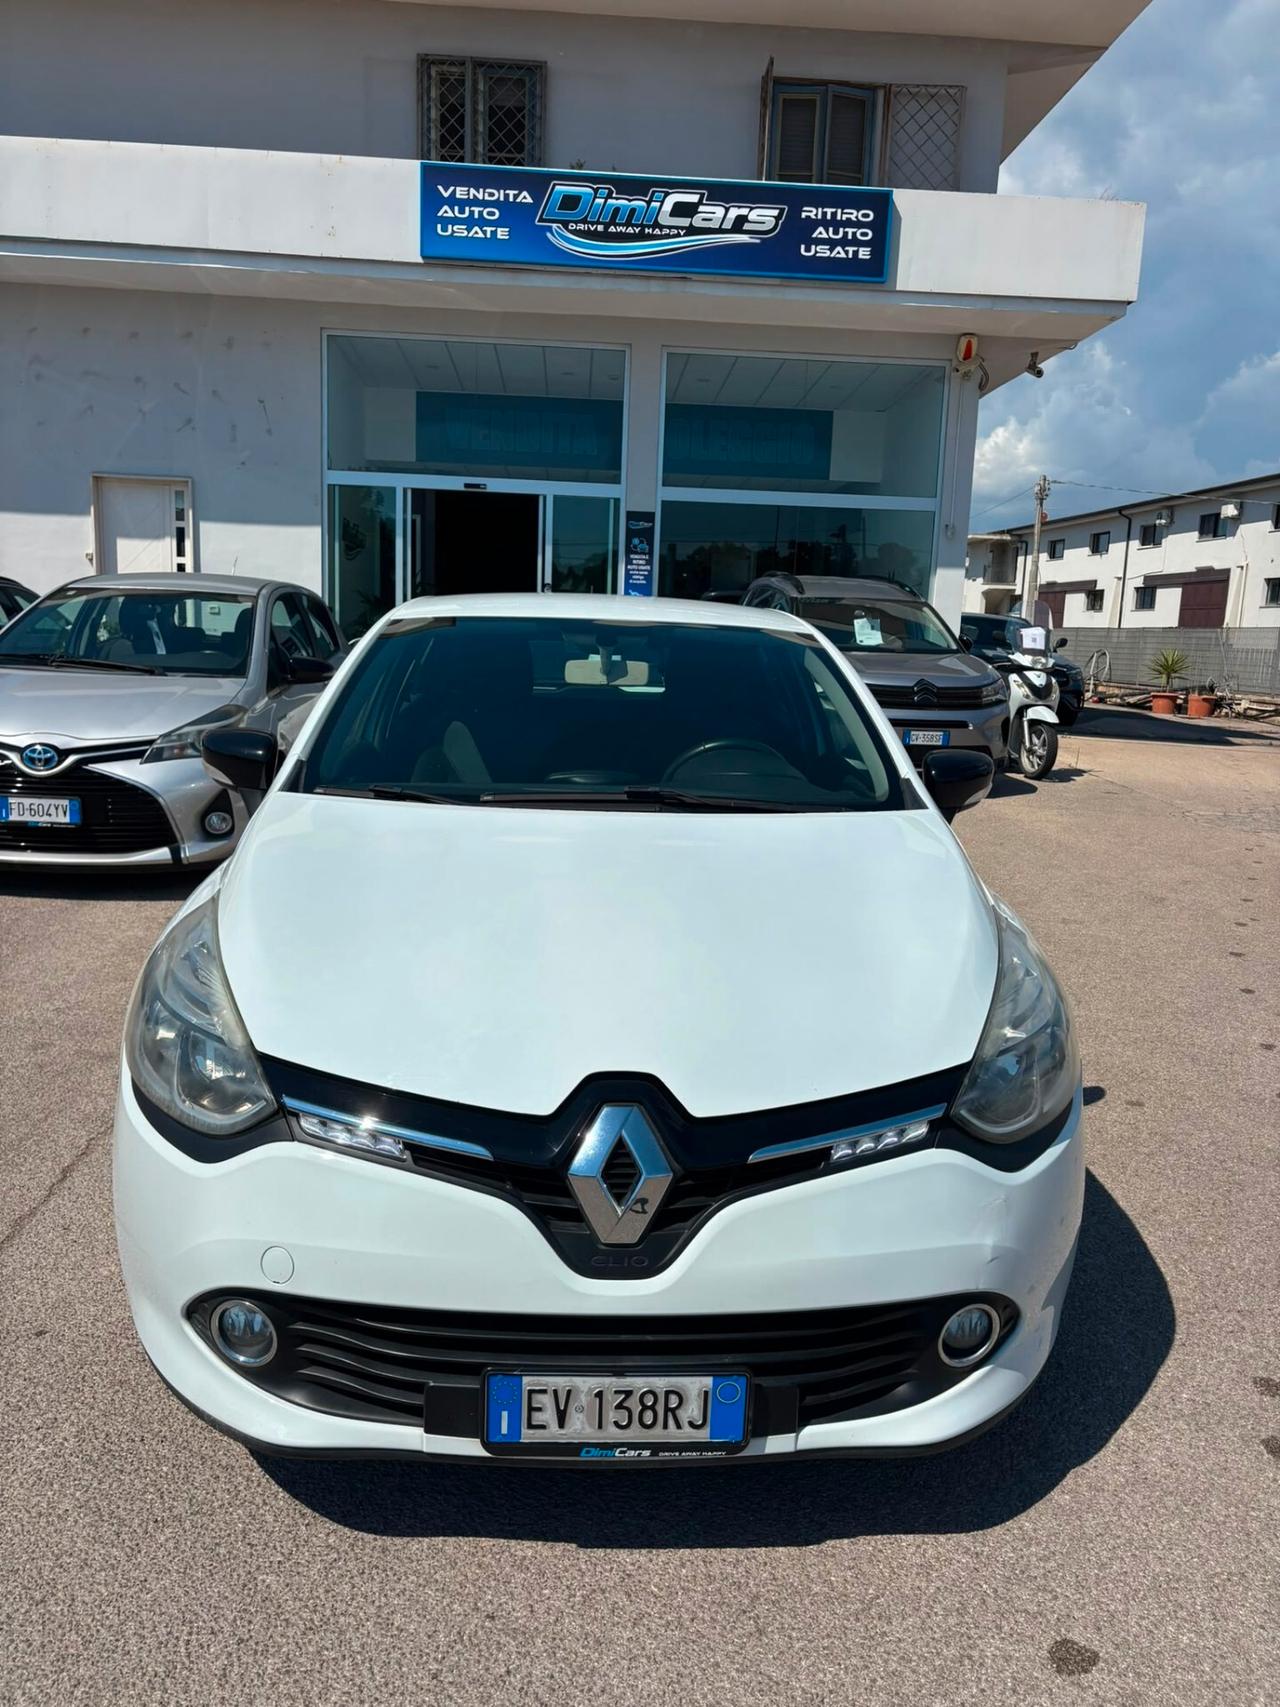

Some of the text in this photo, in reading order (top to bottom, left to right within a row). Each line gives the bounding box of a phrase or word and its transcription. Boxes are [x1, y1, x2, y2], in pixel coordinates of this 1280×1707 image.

[436, 185, 534, 203] VENDITA
[436, 204, 500, 220] AUTO
[543, 185, 781, 232] DimiCars
[800, 206, 874, 222] RITIRO
[436, 223, 511, 239] USATE
[568, 222, 686, 236] DRIVE AWAY HAPPY
[811, 226, 873, 240] AUTO
[800, 244, 872, 259] USATE
[591, 1256, 648, 1267] CLIO
[526, 1388, 572, 1430] EV
[593, 1388, 709, 1430] 138RJ
[580, 1447, 651, 1457] DimiCars
